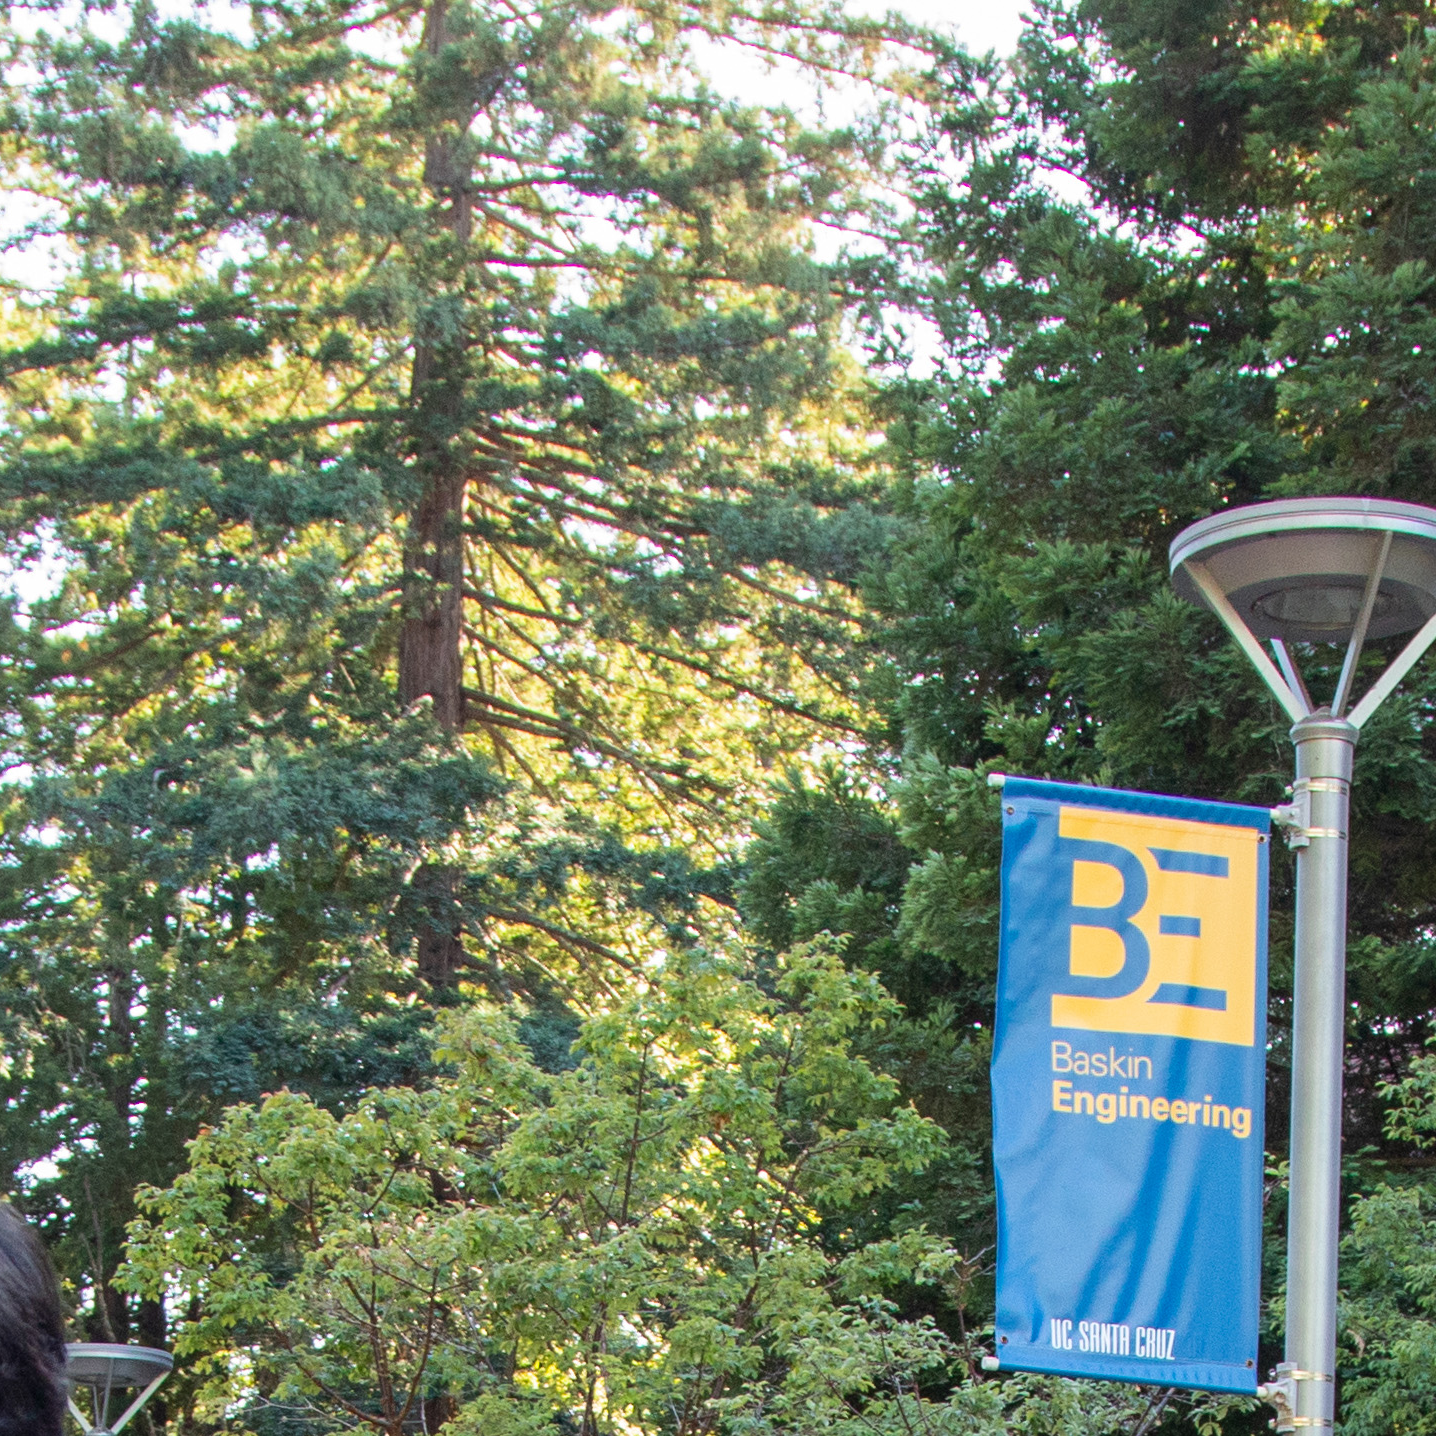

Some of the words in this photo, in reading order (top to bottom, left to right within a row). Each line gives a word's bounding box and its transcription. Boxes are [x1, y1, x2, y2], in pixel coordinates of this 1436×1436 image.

[1053, 835, 1230, 1011] BE
[1051, 1040, 1153, 1080] Baskin
[1052, 1079, 1253, 1139] Engineering
[1050, 1318, 1073, 1350] UC
[1078, 1320, 1130, 1356] SANTA
[1135, 1326, 1176, 1361] CRUZ
